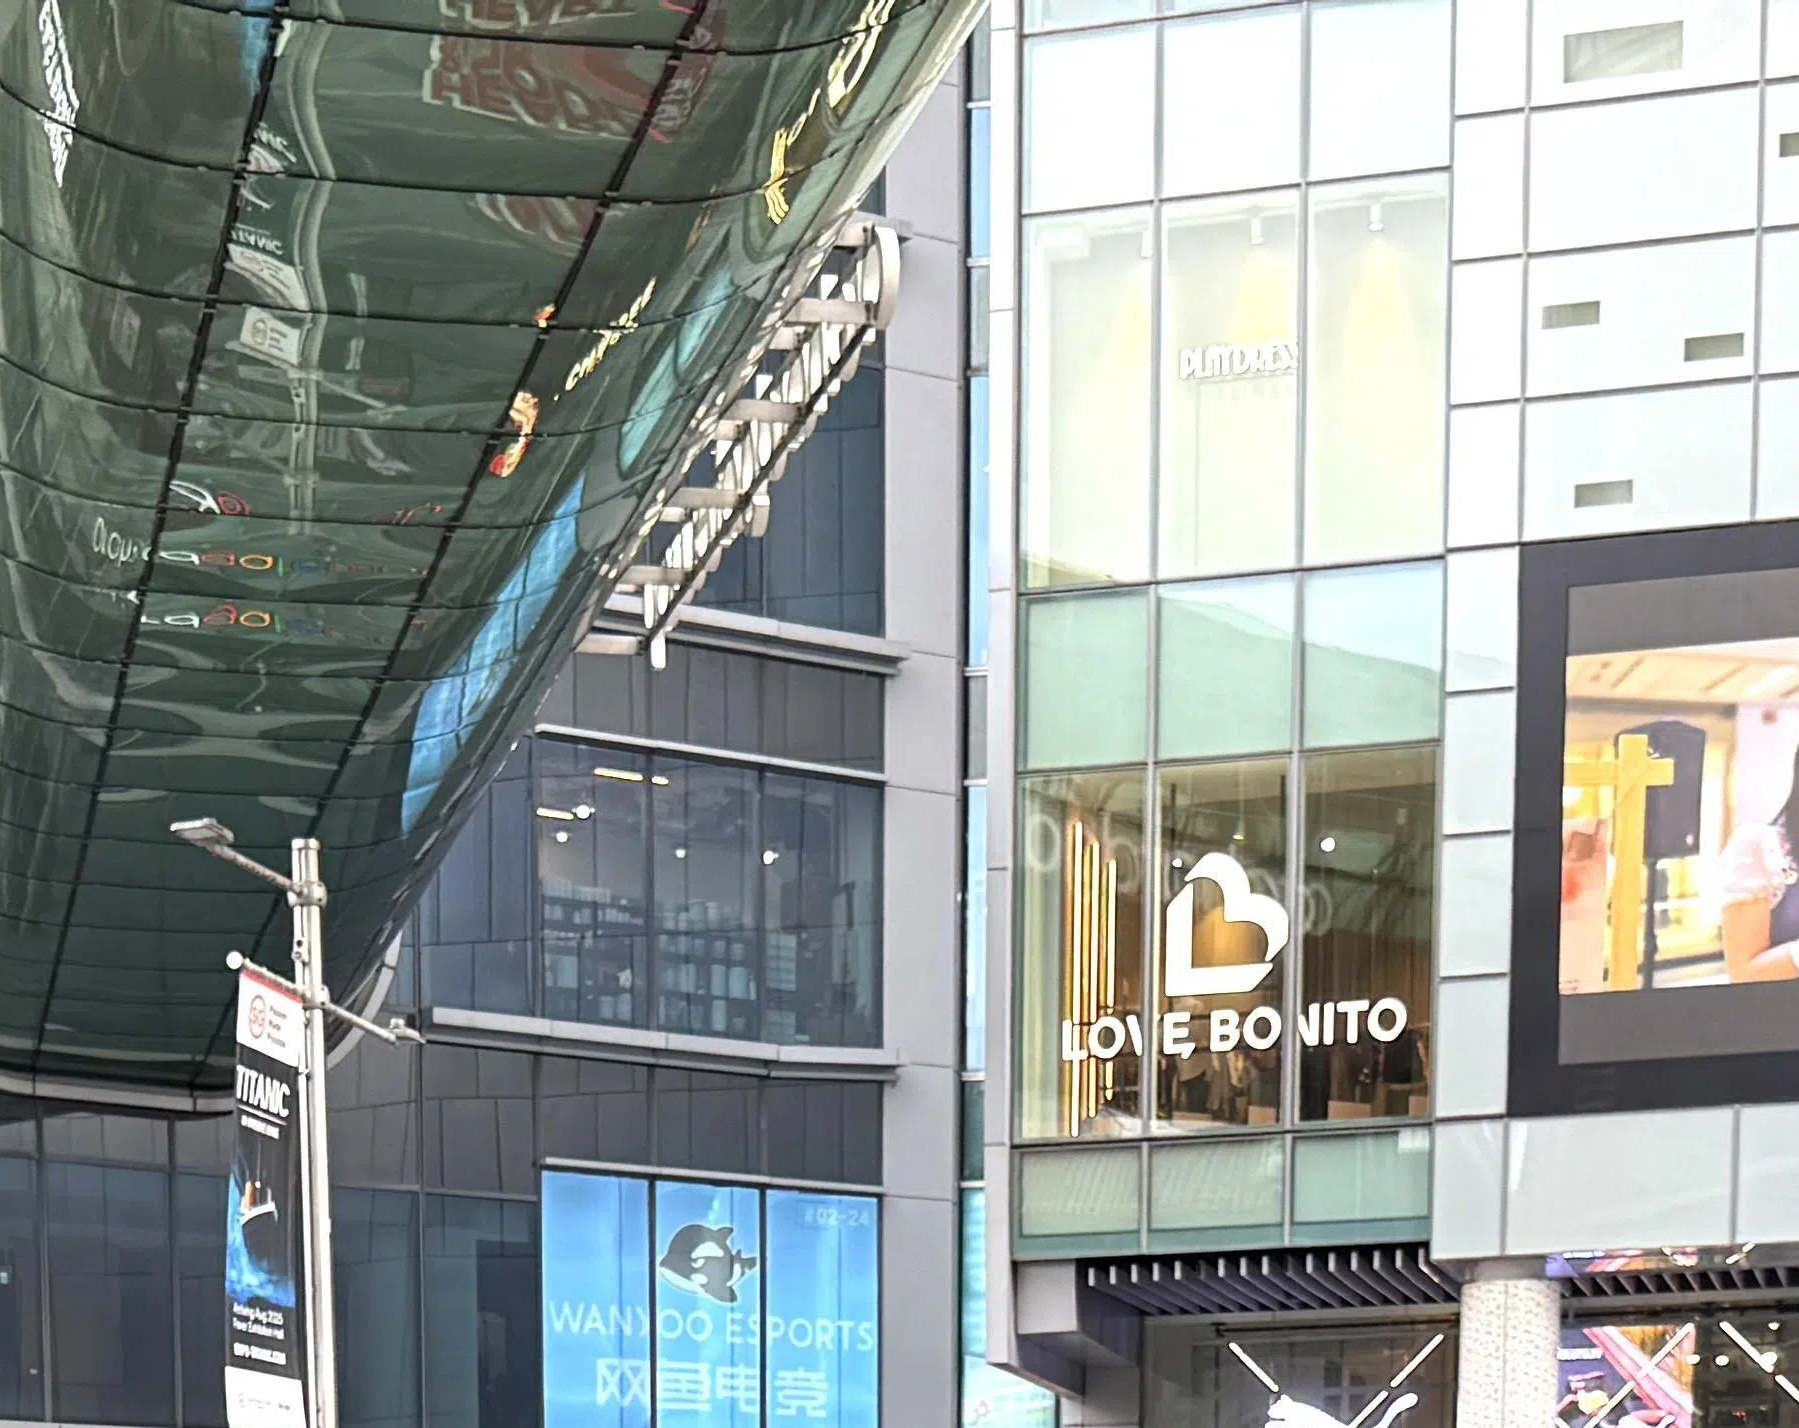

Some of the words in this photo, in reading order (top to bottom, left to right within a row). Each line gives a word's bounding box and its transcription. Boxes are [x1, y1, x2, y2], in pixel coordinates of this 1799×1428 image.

[1210, 996, 1408, 1053] BONITO
[236, 1064, 291, 1118] TITANIC
[726, 1311, 874, 1350] ESPORTS
